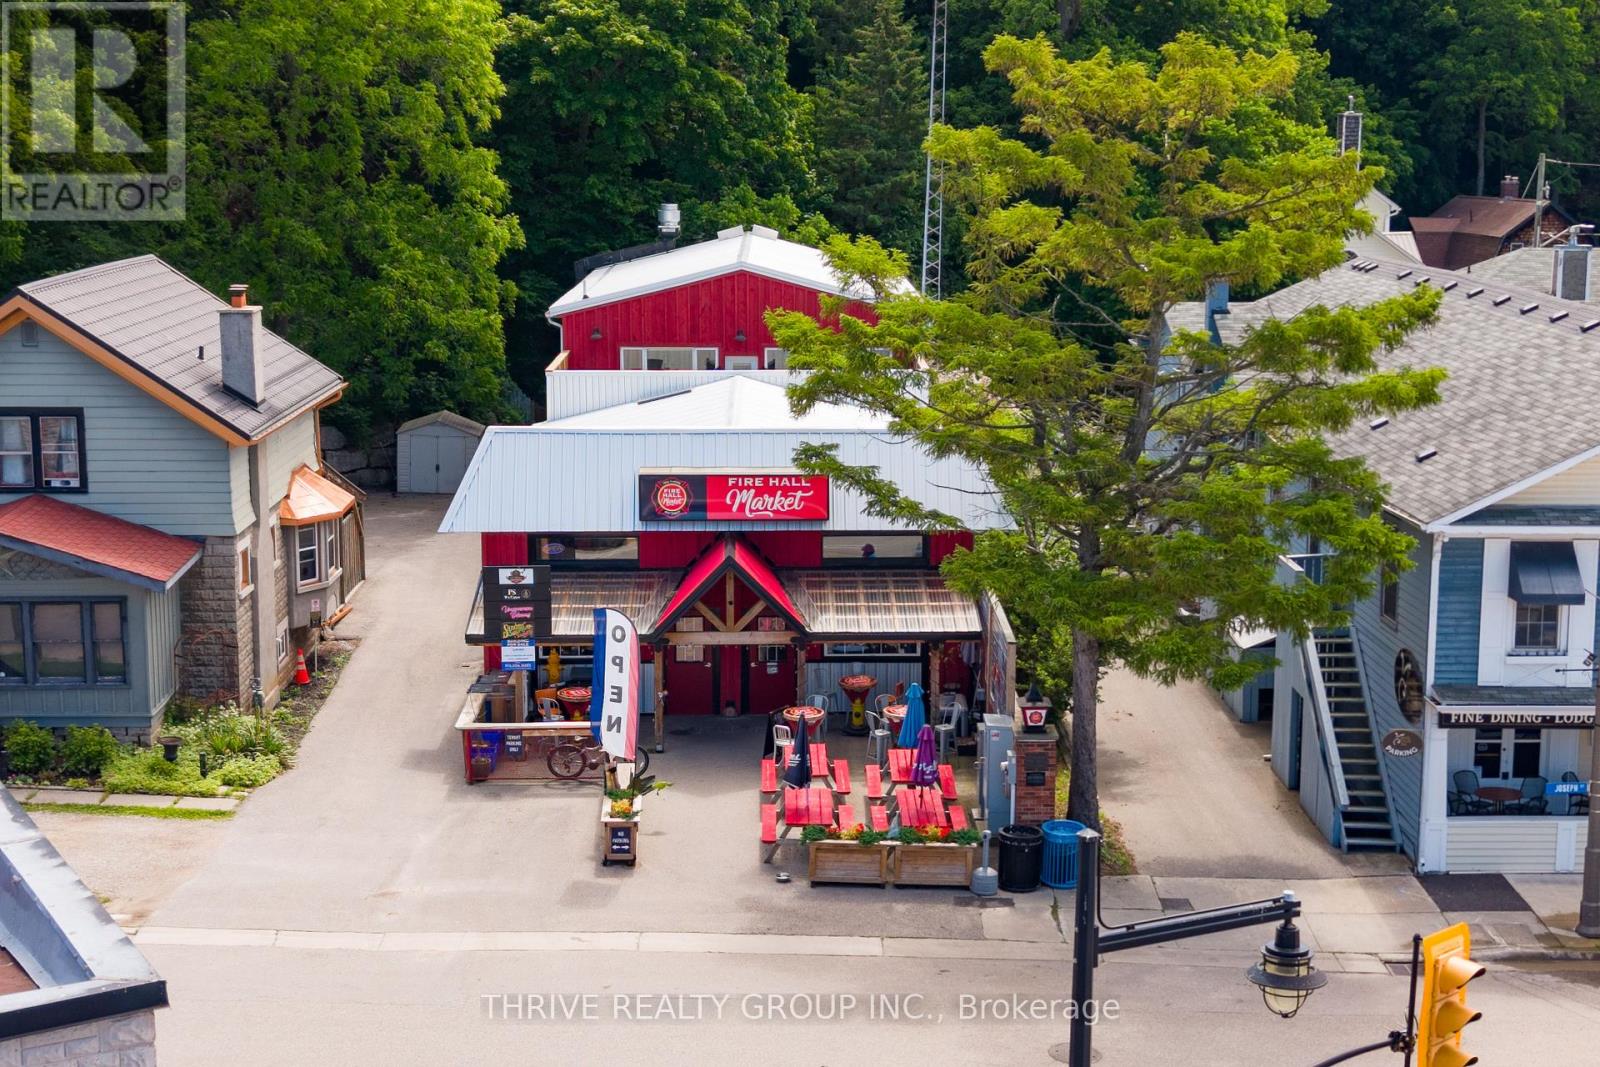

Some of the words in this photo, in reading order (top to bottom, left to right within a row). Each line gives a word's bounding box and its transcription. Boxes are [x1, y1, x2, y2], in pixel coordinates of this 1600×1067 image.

[728, 477, 764, 487] FIRE
[769, 477, 811, 487] HALL
[726, 488, 814, 518] Market
[1450, 713, 1485, 723] FINE
[1490, 713, 1542, 723] DINING
[1385, 745, 1418, 757] PARKING
[1554, 783, 1579, 793] JOSEPH
